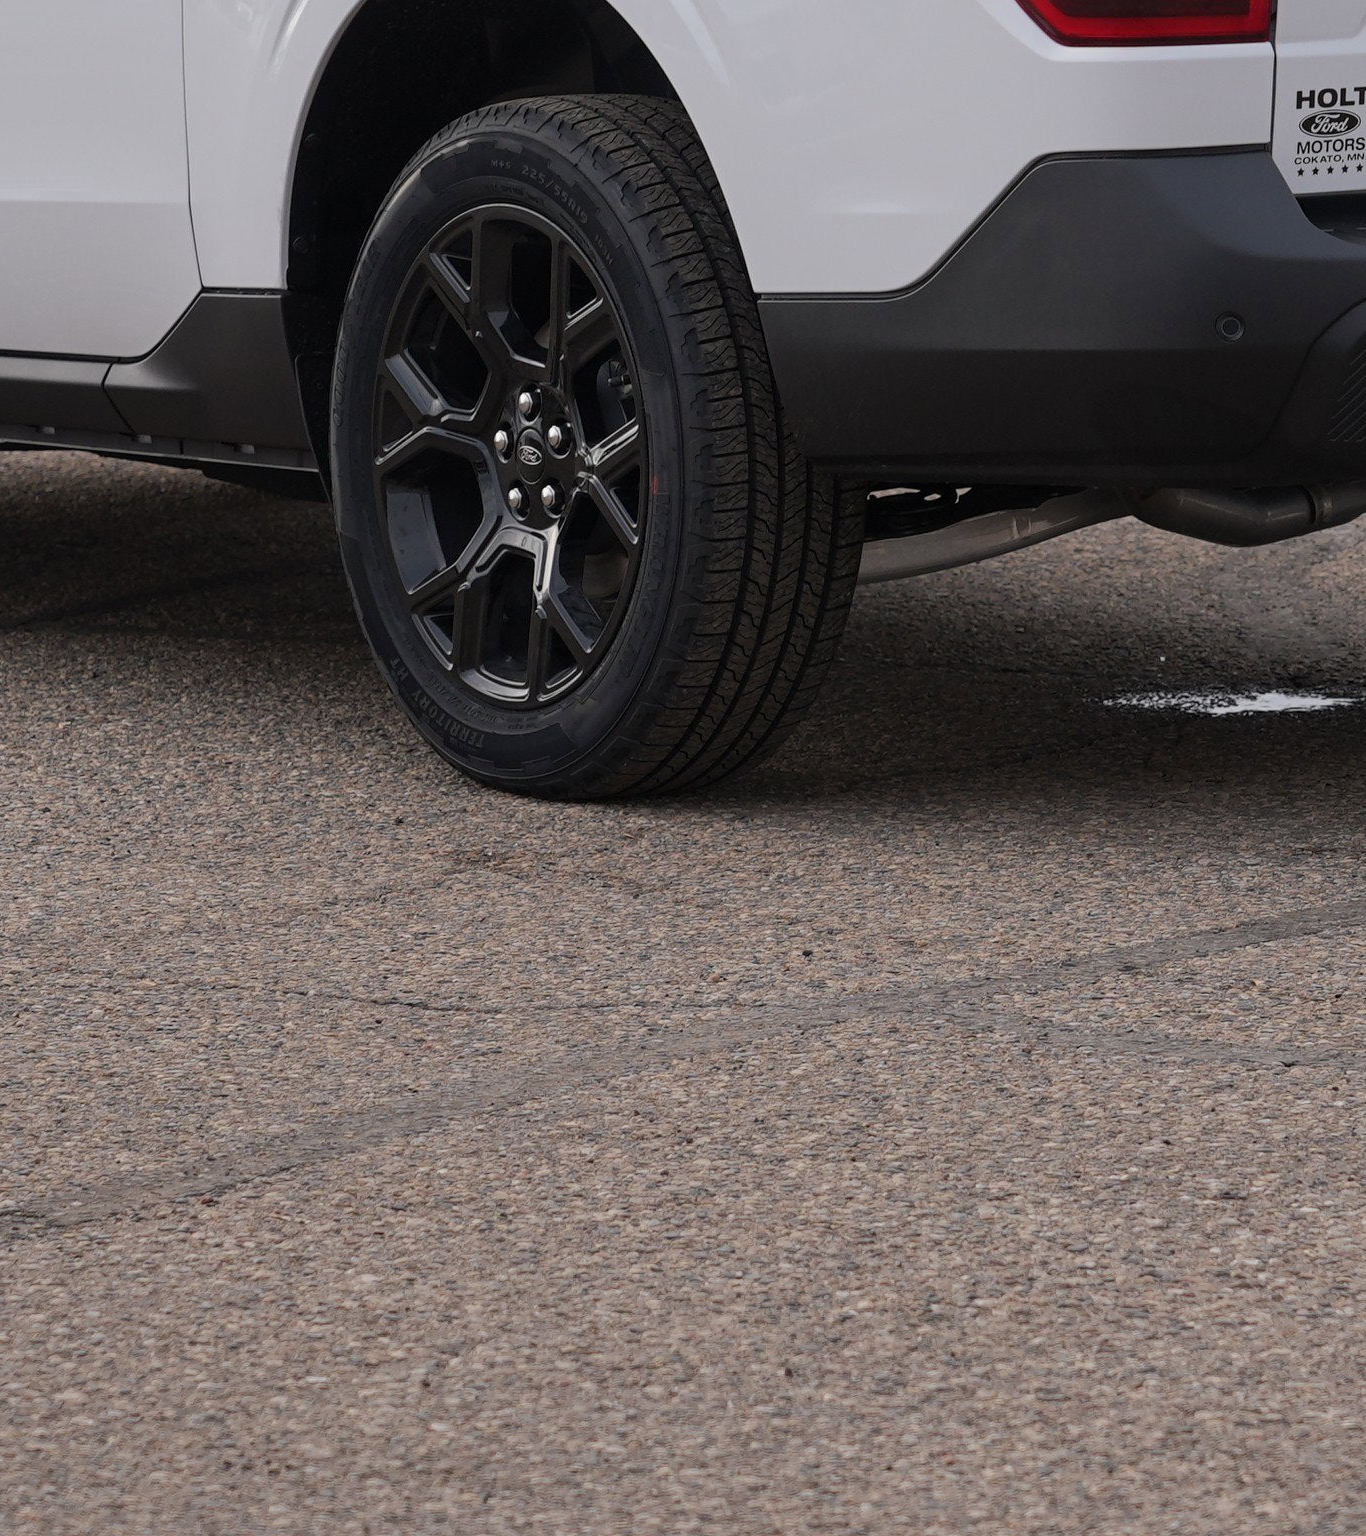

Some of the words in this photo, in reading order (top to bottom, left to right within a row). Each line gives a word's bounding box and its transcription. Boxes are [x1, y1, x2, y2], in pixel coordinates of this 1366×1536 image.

[1310, 113, 1350, 134] Ford
[1296, 137, 1366, 154] MOTORS
[1294, 154, 1345, 165] COKATO,
[1347, 153, 1365, 161] MN
